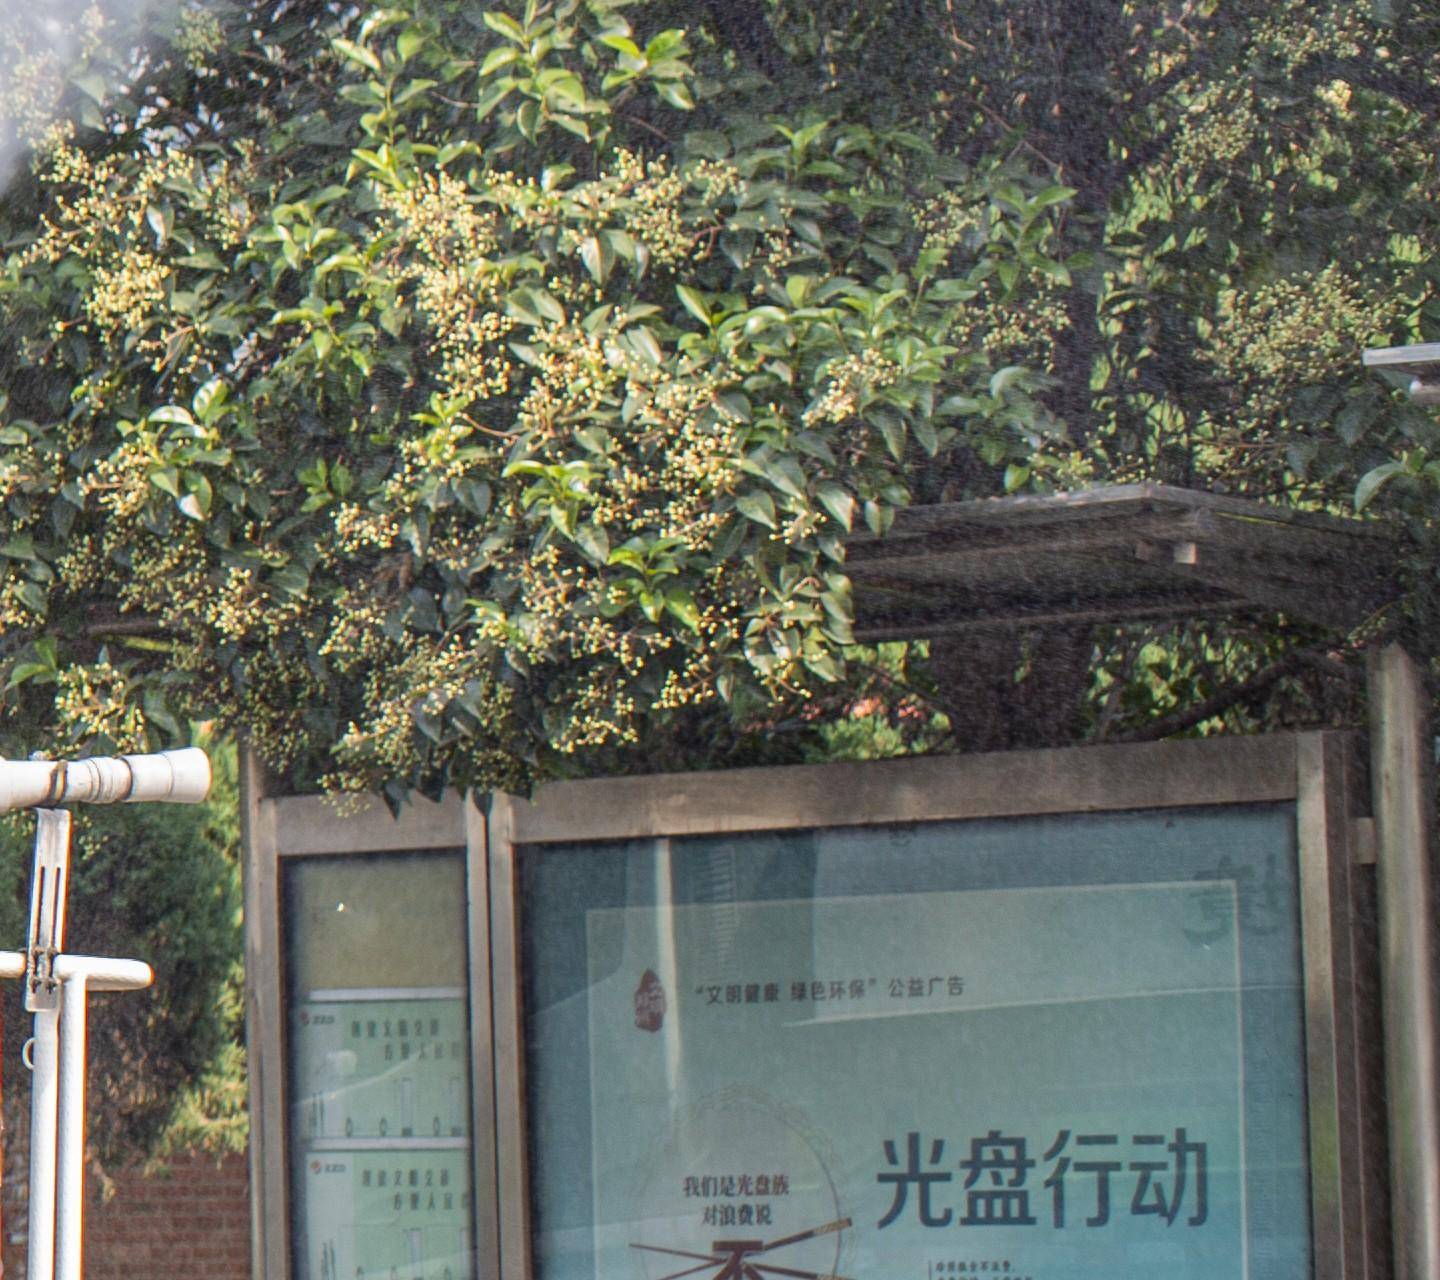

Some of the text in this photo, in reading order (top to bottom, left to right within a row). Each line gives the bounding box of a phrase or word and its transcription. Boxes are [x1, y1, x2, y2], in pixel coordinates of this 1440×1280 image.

[887, 974, 966, 998] 公益广告
[682, 1174, 790, 1198] 我们是光盘族
[876, 1126, 1210, 1230] 光盘行动
[701, 1203, 773, 1227] 对浪费说
